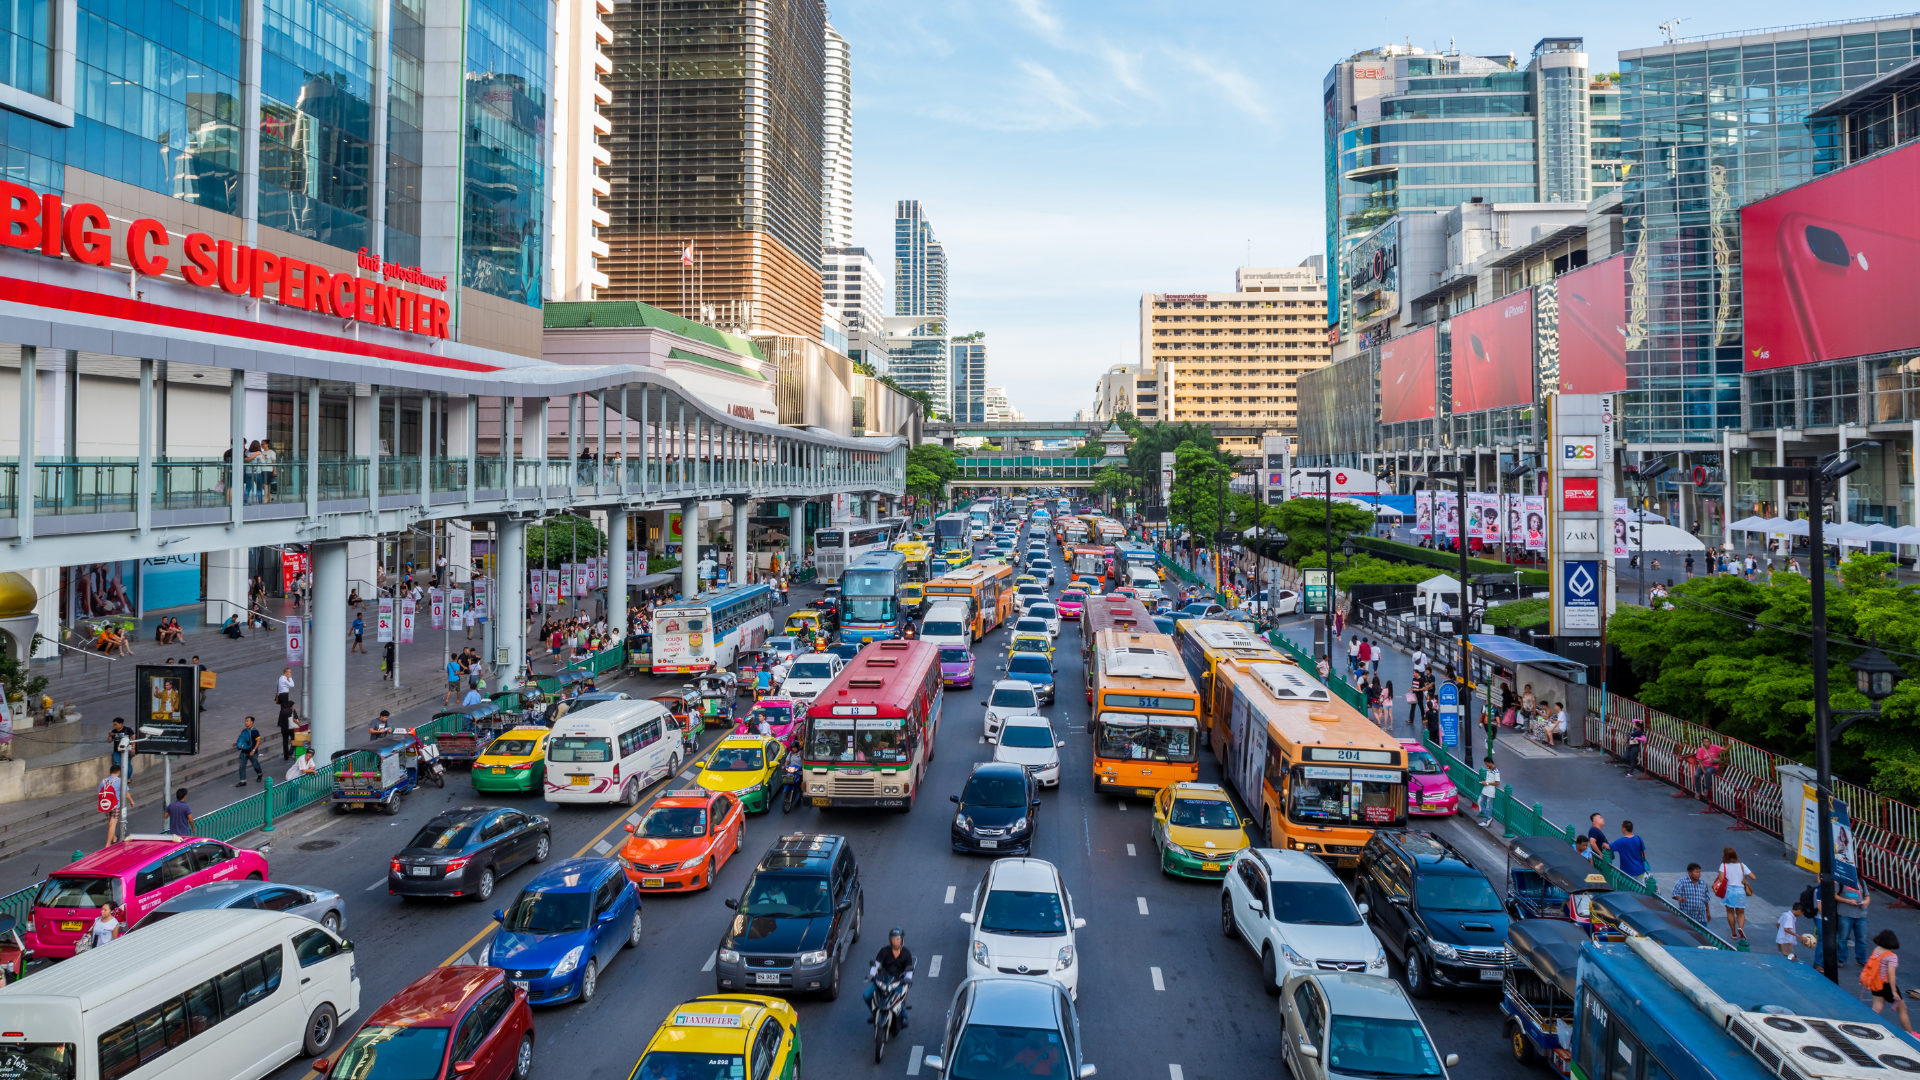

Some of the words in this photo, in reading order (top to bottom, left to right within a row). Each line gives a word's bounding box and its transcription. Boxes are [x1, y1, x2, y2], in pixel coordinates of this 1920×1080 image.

[1355, 68, 1385, 79] ZEN
[0, 179, 111, 267] BIG
[126, 218, 169, 276] C
[180, 232, 451, 340] SUPERCENTER
[1509, 304, 1523, 318] iPhone
[1523, 301, 1528, 313] 7
[1760, 350, 1770, 359] AIS
[1602, 398, 1613, 461] centralworld
[1564, 444, 1595, 459] B2S
[1486, 532, 1500, 540] 80%
[1566, 532, 1596, 540] ZARA
[1529, 538, 1544, 546] 80%
[1139, 699, 1160, 708] 514
[851, 706, 859, 715] 13
[1338, 750, 1360, 760] 204
[1584, 993, 1608, 1027] 4-4047
[685, 1015, 733, 1026] TAXIMETER
